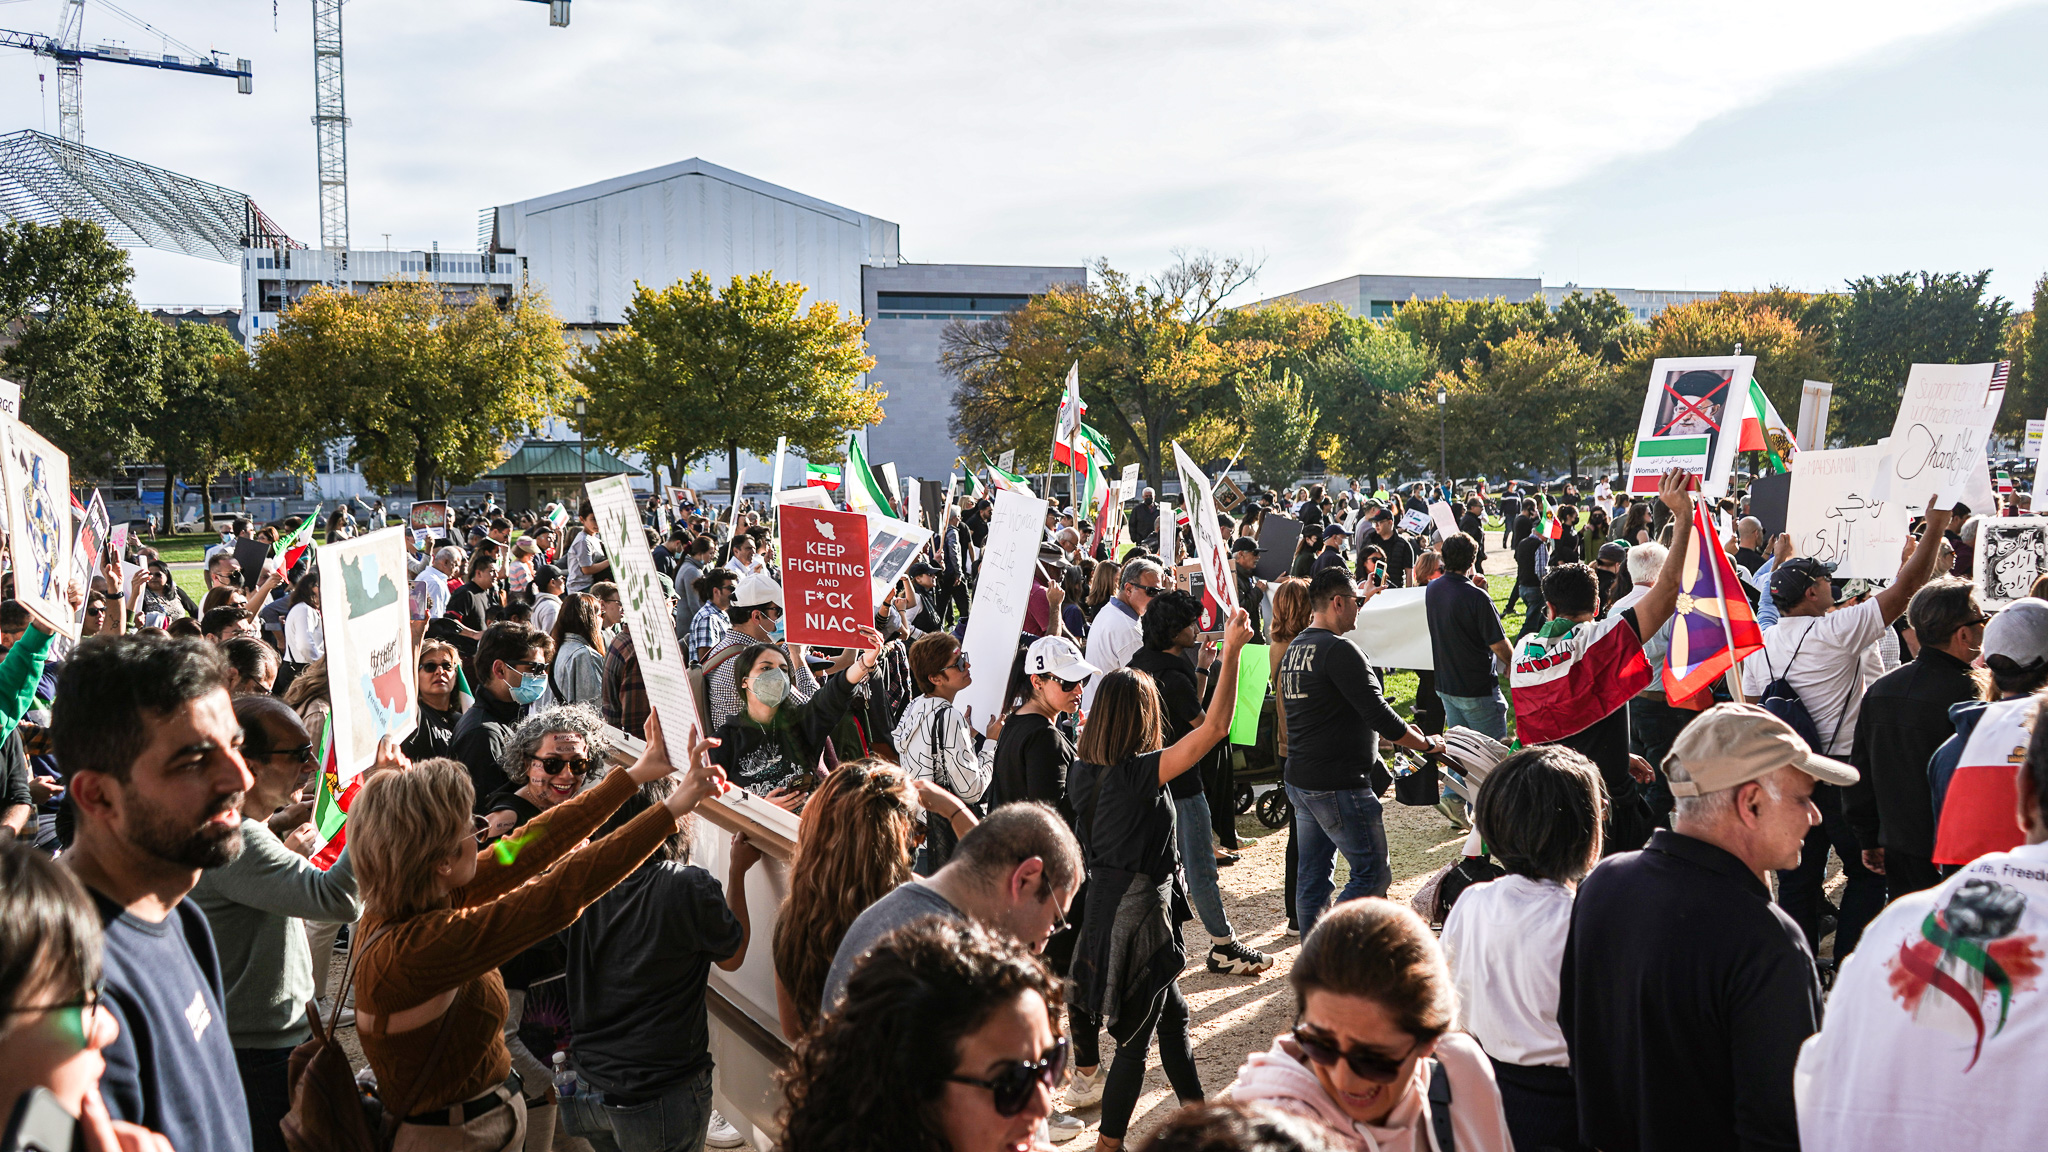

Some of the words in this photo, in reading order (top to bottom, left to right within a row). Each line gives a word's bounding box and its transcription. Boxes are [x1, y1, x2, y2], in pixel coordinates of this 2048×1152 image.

[806, 541, 846, 558] KEEP
[788, 558, 865, 577] FIGHTING
[1995, 549, 2034, 575] آزادی
[816, 578, 840, 588] AND
[1995, 570, 2034, 596] آزادی
[805, 613, 856, 633] NIAC
[1035, 655, 1045, 670] 3
[367, 690, 380, 715] Persian
